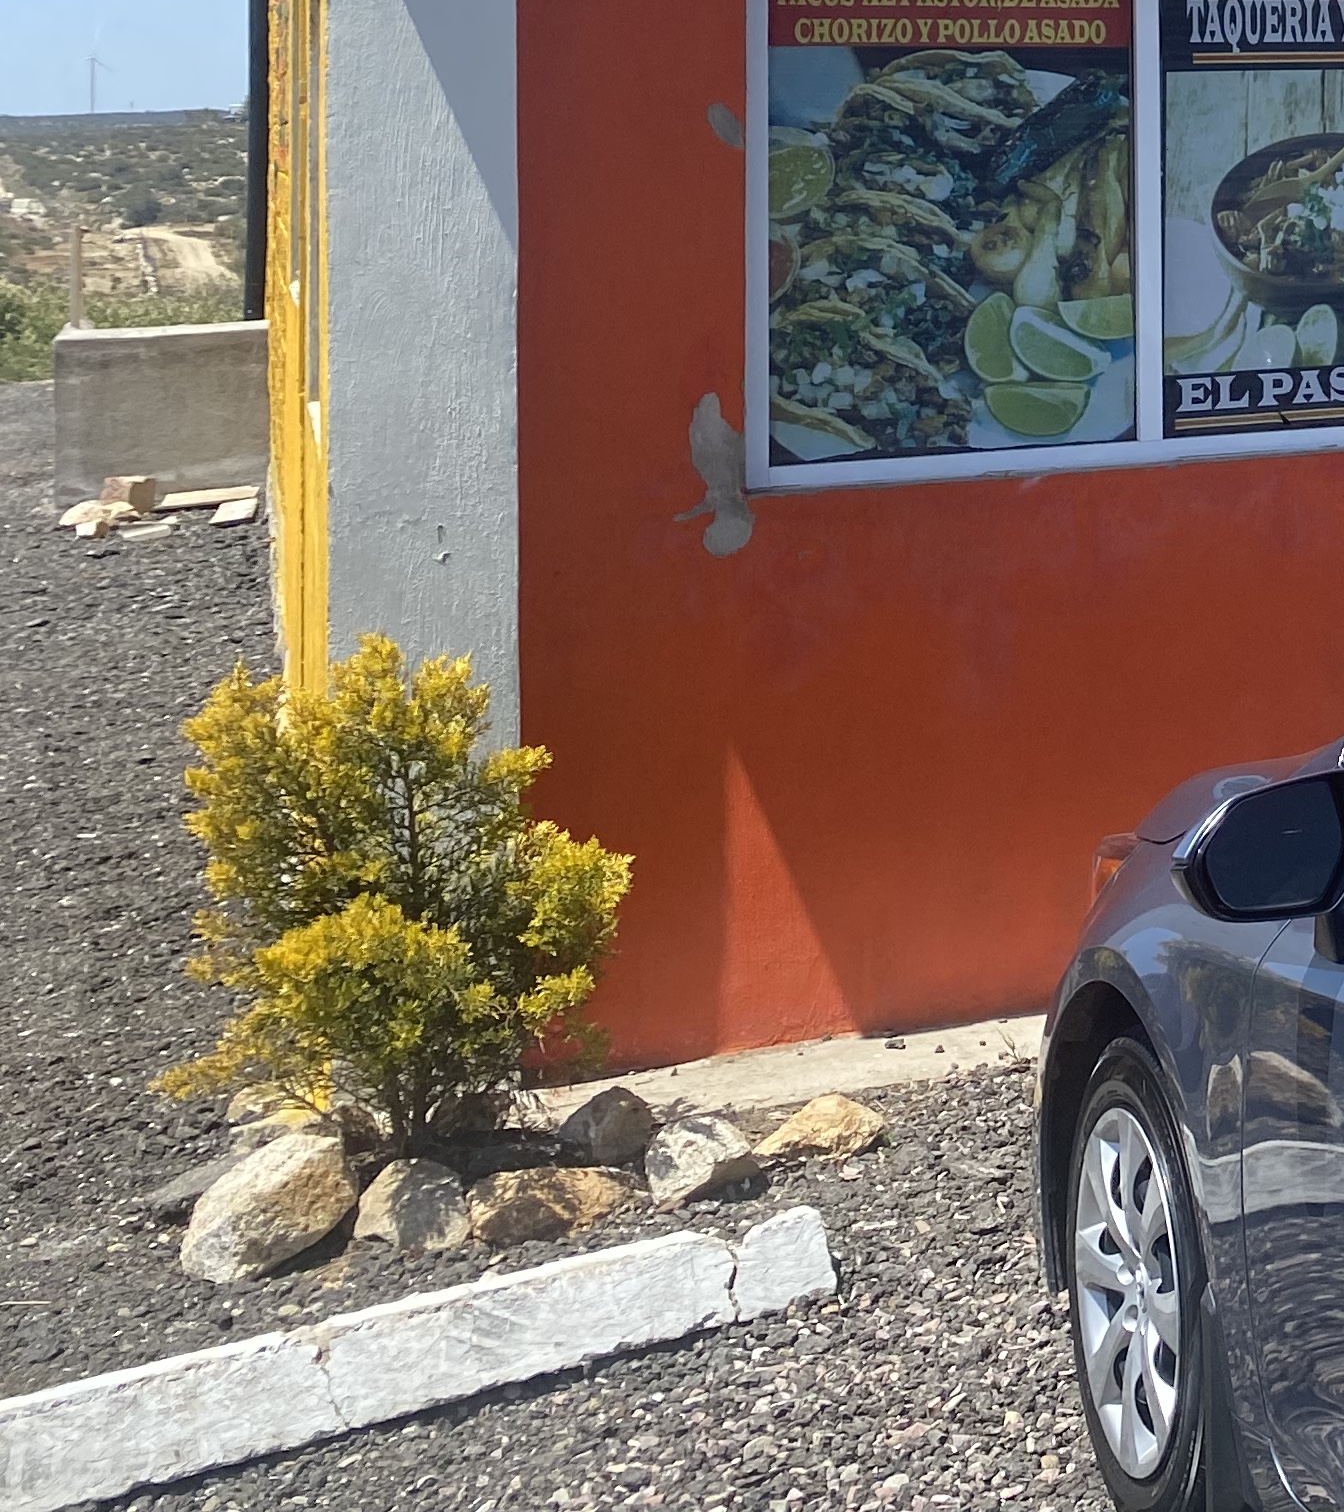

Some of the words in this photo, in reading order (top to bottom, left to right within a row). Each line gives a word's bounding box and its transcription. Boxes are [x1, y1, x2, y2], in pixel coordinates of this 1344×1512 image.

[794, 17, 913, 44] CHORIZO
[916, 18, 931, 43] Y
[936, 18, 1021, 45] POLLO
[1023, 19, 1107, 45] ASADO
[1175, 374, 1250, 413] EL
